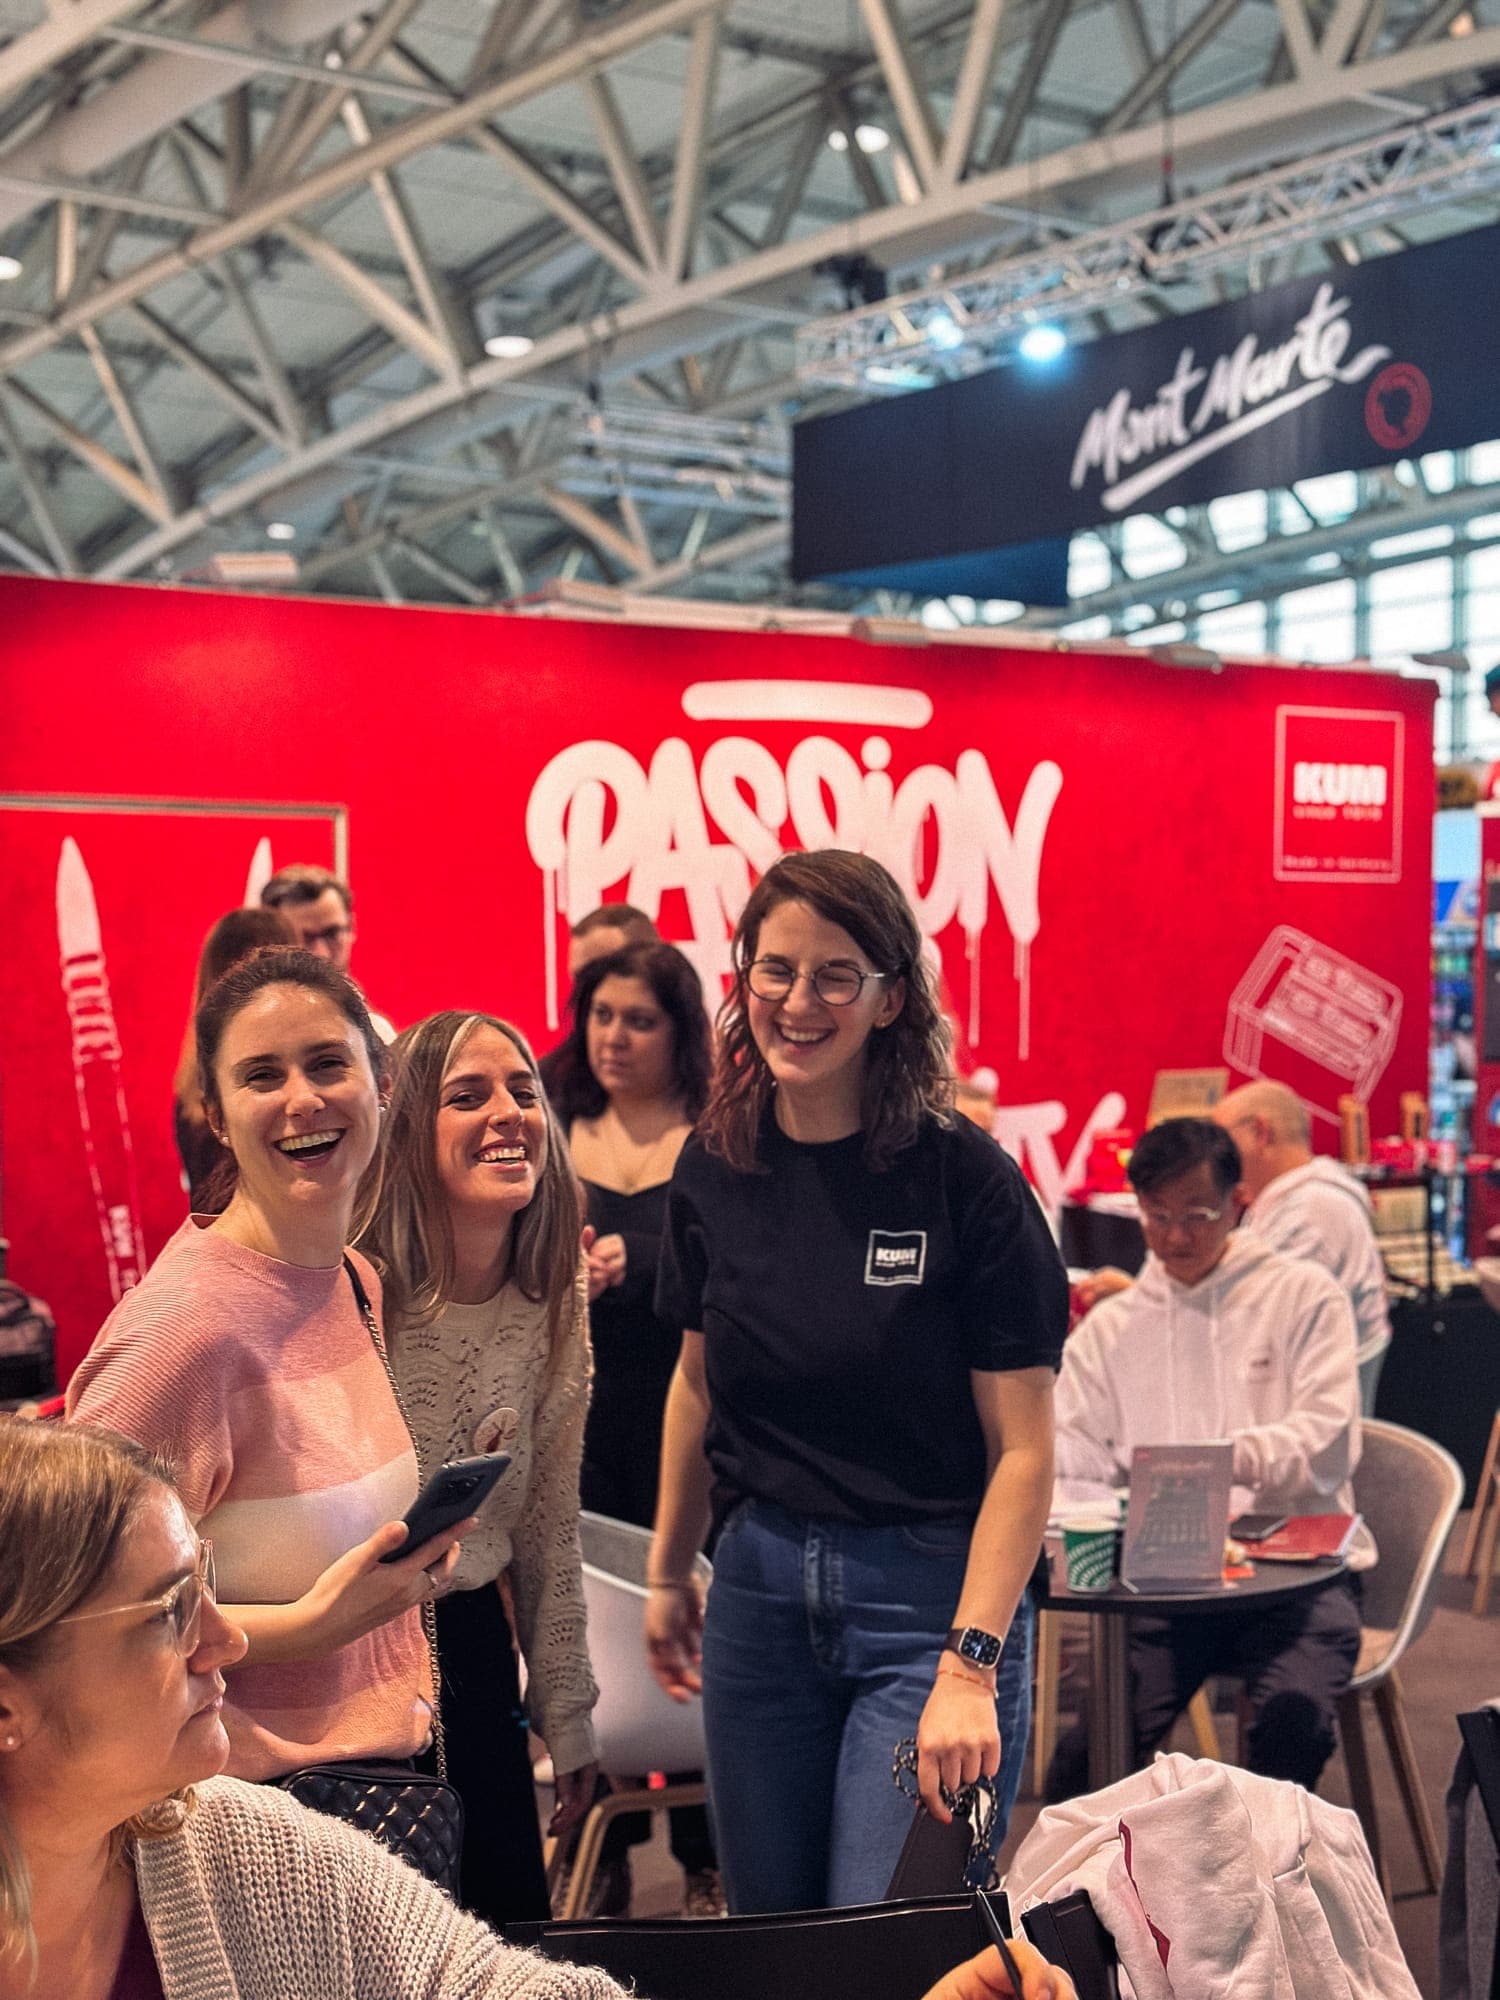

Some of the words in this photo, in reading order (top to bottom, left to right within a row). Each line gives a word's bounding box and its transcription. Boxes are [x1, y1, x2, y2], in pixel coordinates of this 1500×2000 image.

[1070, 347, 1207, 489] Mont
[1191, 282, 1392, 434] Marte
[1293, 762, 1388, 806] KUM
[876, 1248, 917, 1262] KUM
